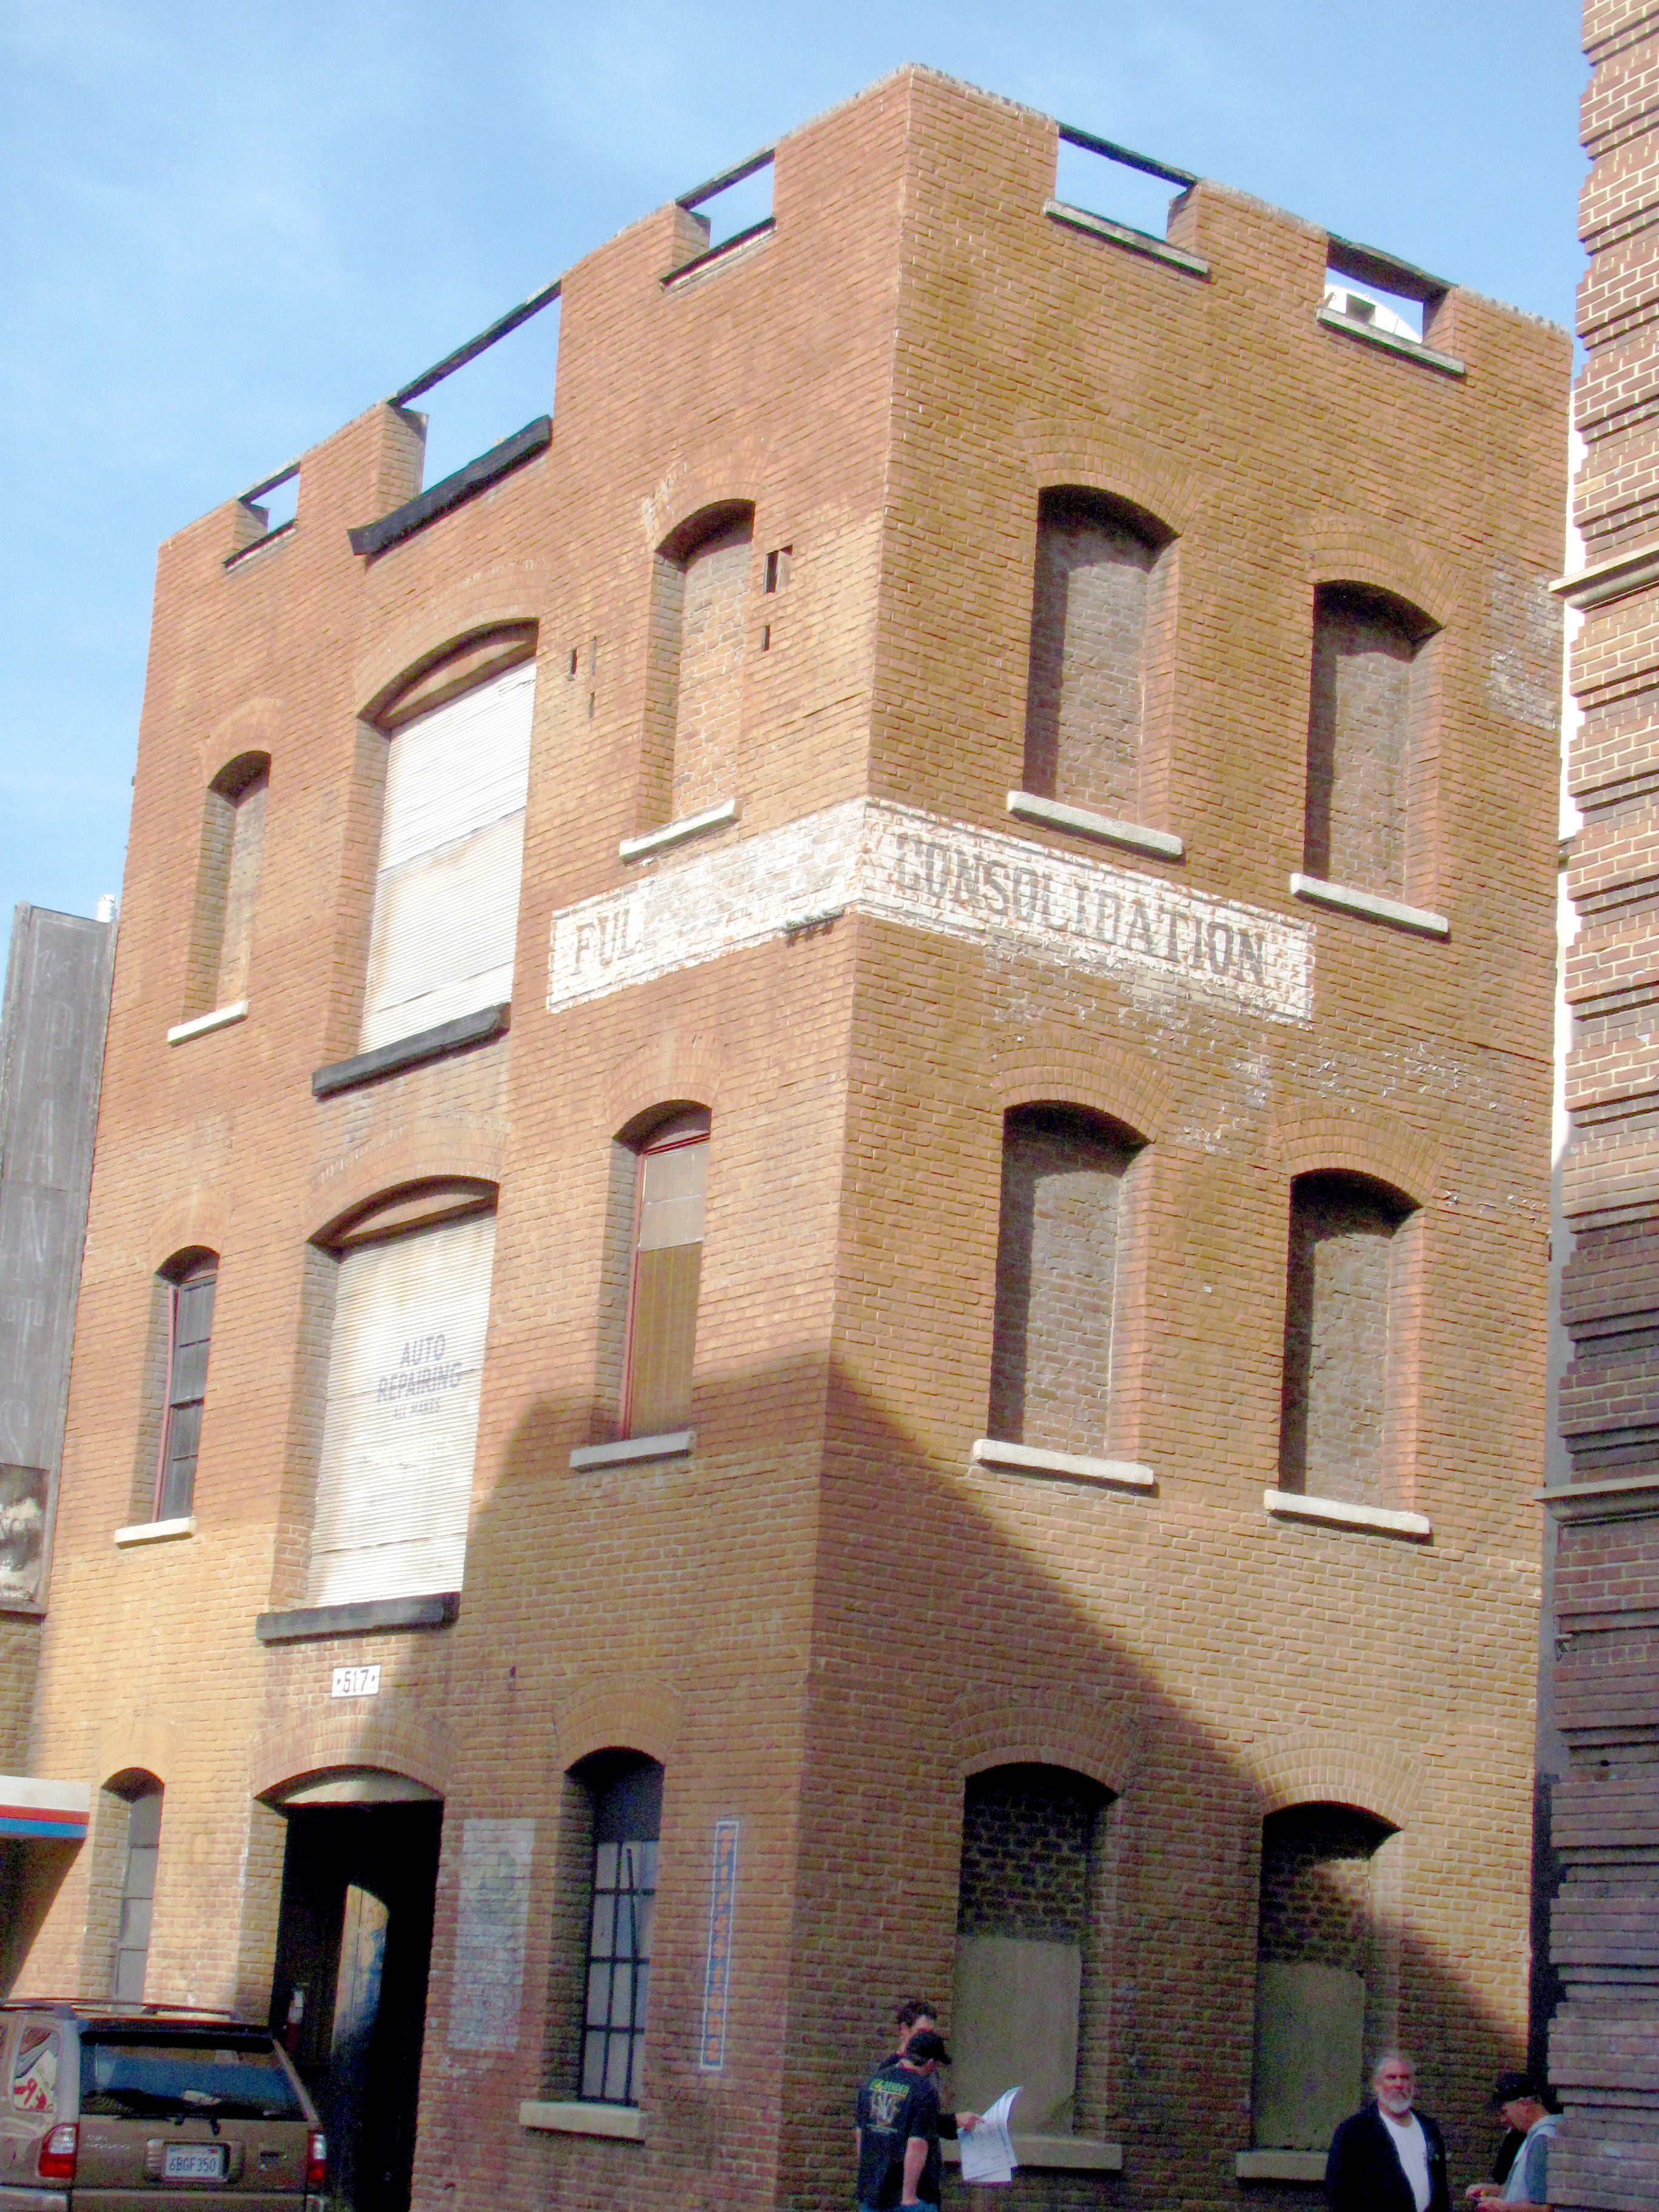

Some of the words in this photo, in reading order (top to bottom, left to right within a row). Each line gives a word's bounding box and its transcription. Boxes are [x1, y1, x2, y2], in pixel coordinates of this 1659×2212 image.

[893, 831, 1267, 987] CONSOLIDATION
[401, 1333, 445, 1367] AUTO
[377, 1361, 463, 1403] REPAIRING
[343, 1669, 369, 1693] 517
